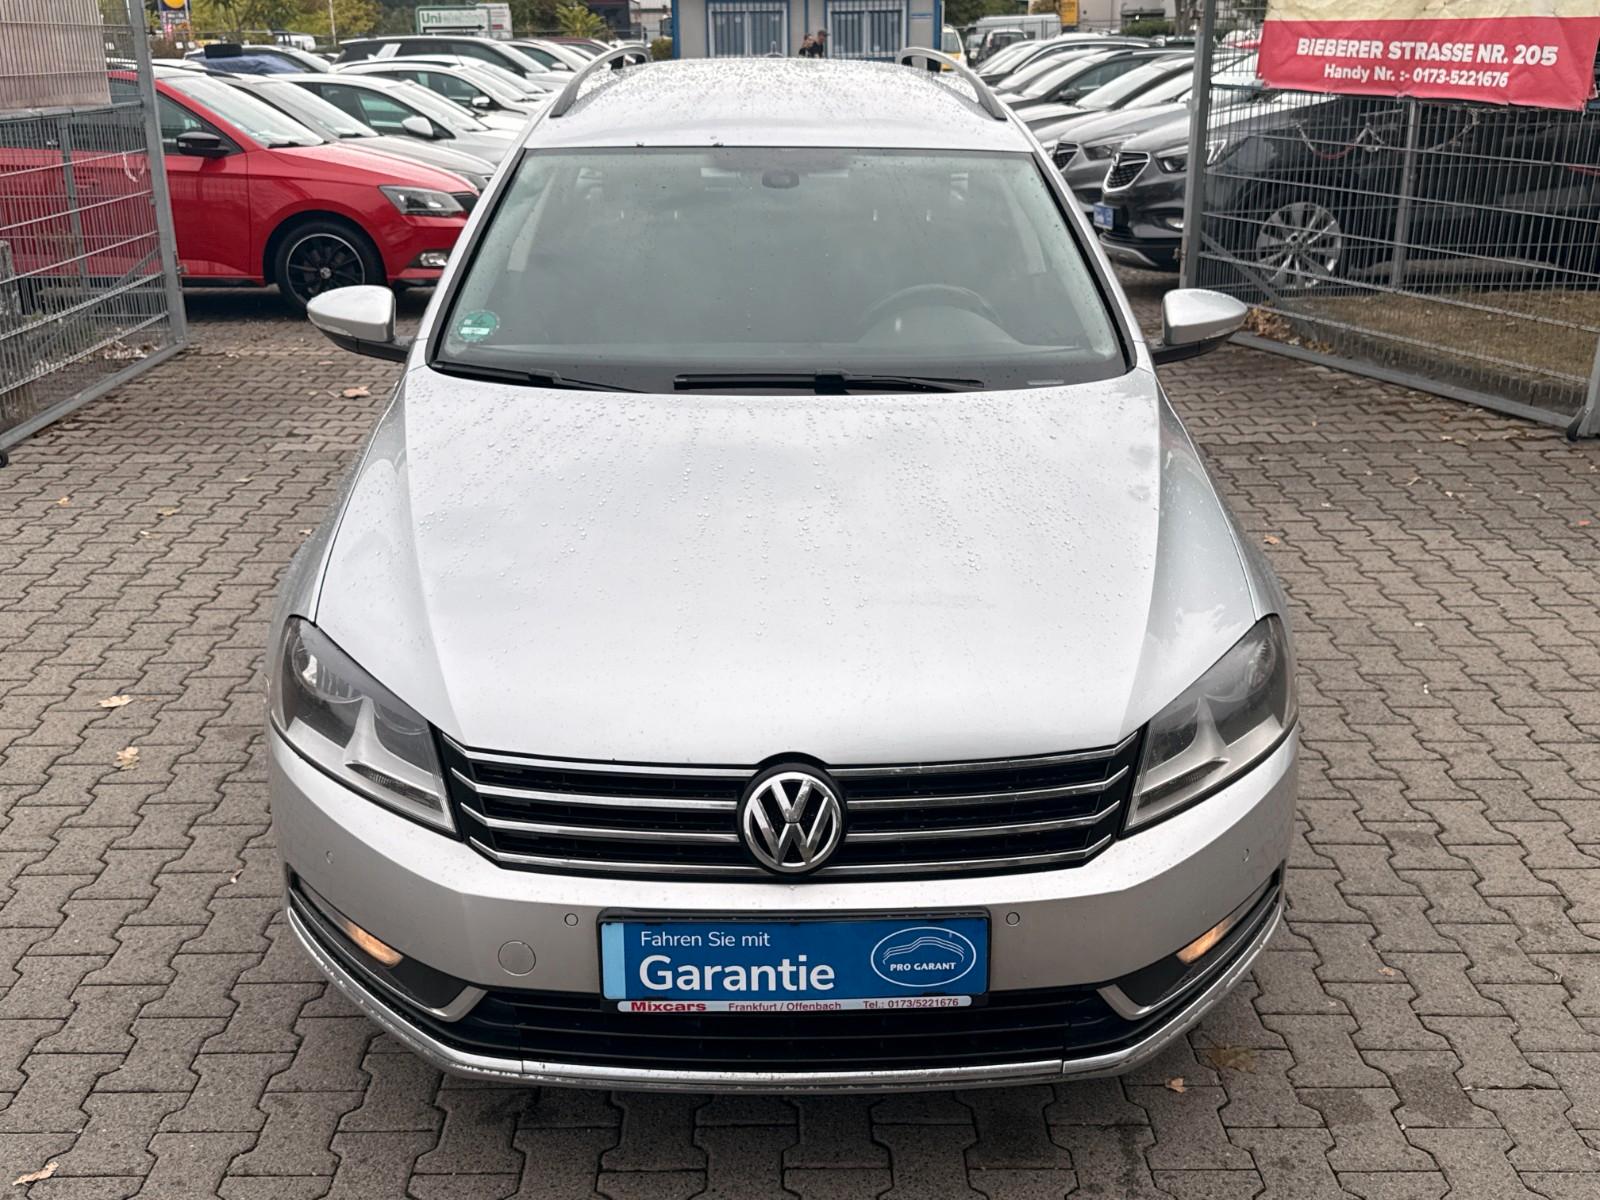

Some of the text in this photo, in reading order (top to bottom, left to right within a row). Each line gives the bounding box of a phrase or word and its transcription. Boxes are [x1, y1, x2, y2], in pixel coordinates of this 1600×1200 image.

[1296, 37, 1559, 66] BIEBERER STRASSE NR. 205
[1323, 63, 1370, 83] Handy
[1373, 65, 1396, 82] Nr.
[1412, 67, 1510, 88] 0173-5221676
[641, 931, 771, 947] Fahren Sie mit
[639, 954, 835, 991] Garantie
[890, 962, 957, 971] PRO GARANT
[631, 1001, 707, 1012] Mixcars
[728, 1001, 778, 1012] Frankfurt
[786, 1000, 842, 1011] Offenbach
[887, 998, 959, 1008] 0173/5221676
